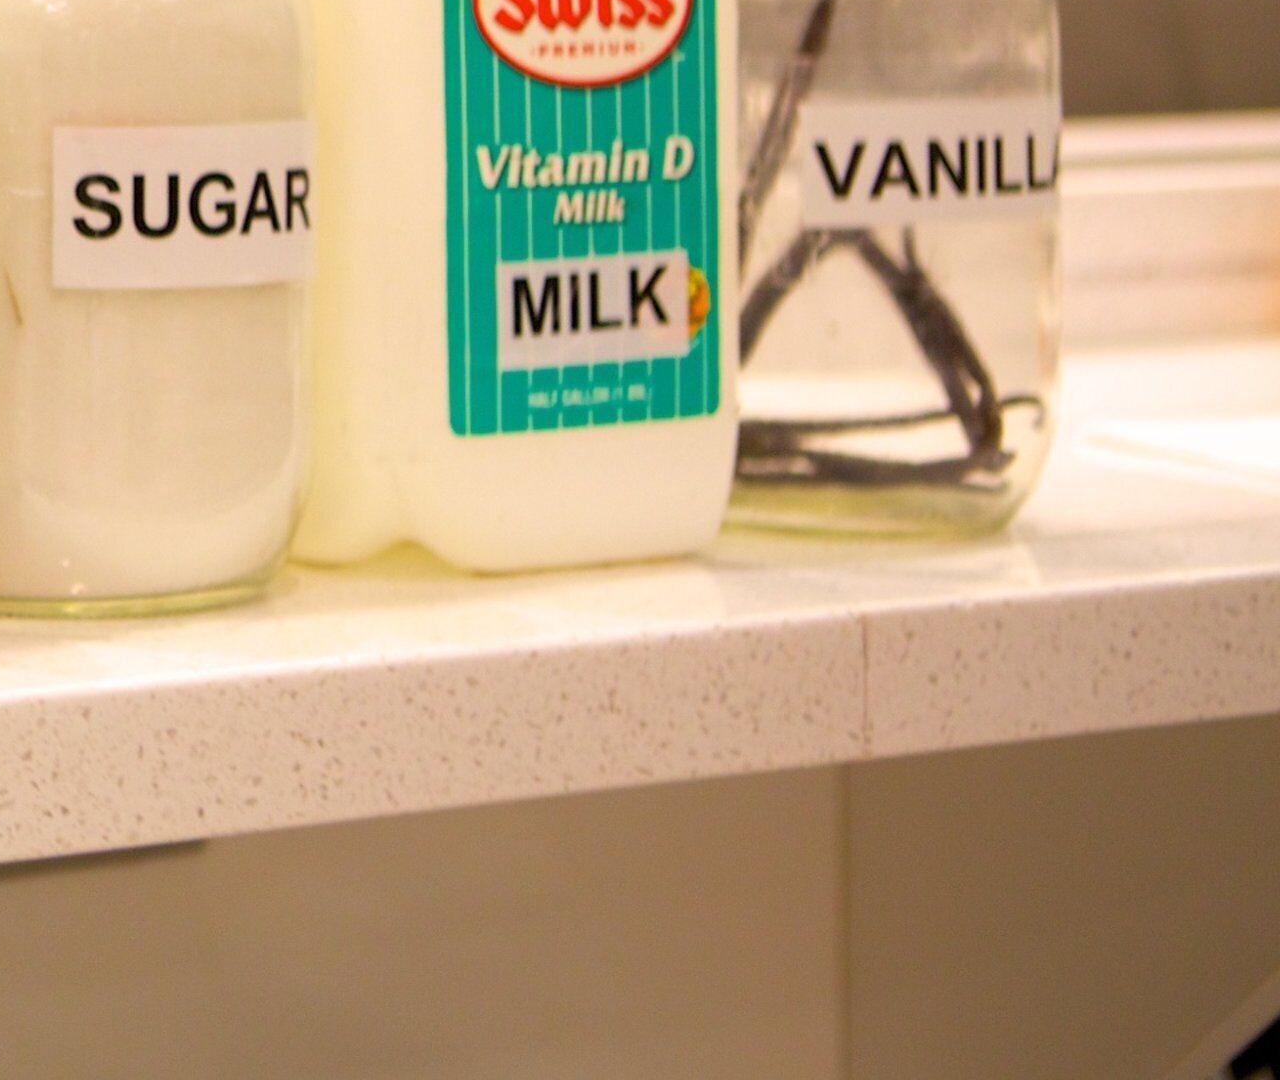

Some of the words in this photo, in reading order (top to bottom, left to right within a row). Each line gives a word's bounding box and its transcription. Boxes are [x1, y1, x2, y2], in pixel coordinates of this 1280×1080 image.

[476, 137, 651, 190] Vitamin
[662, 133, 695, 183] D
[814, 129, 1060, 201] VANILL
[72, 167, 312, 239] SUGAR
[553, 188, 626, 225] Milk
[511, 263, 670, 338] MILK
